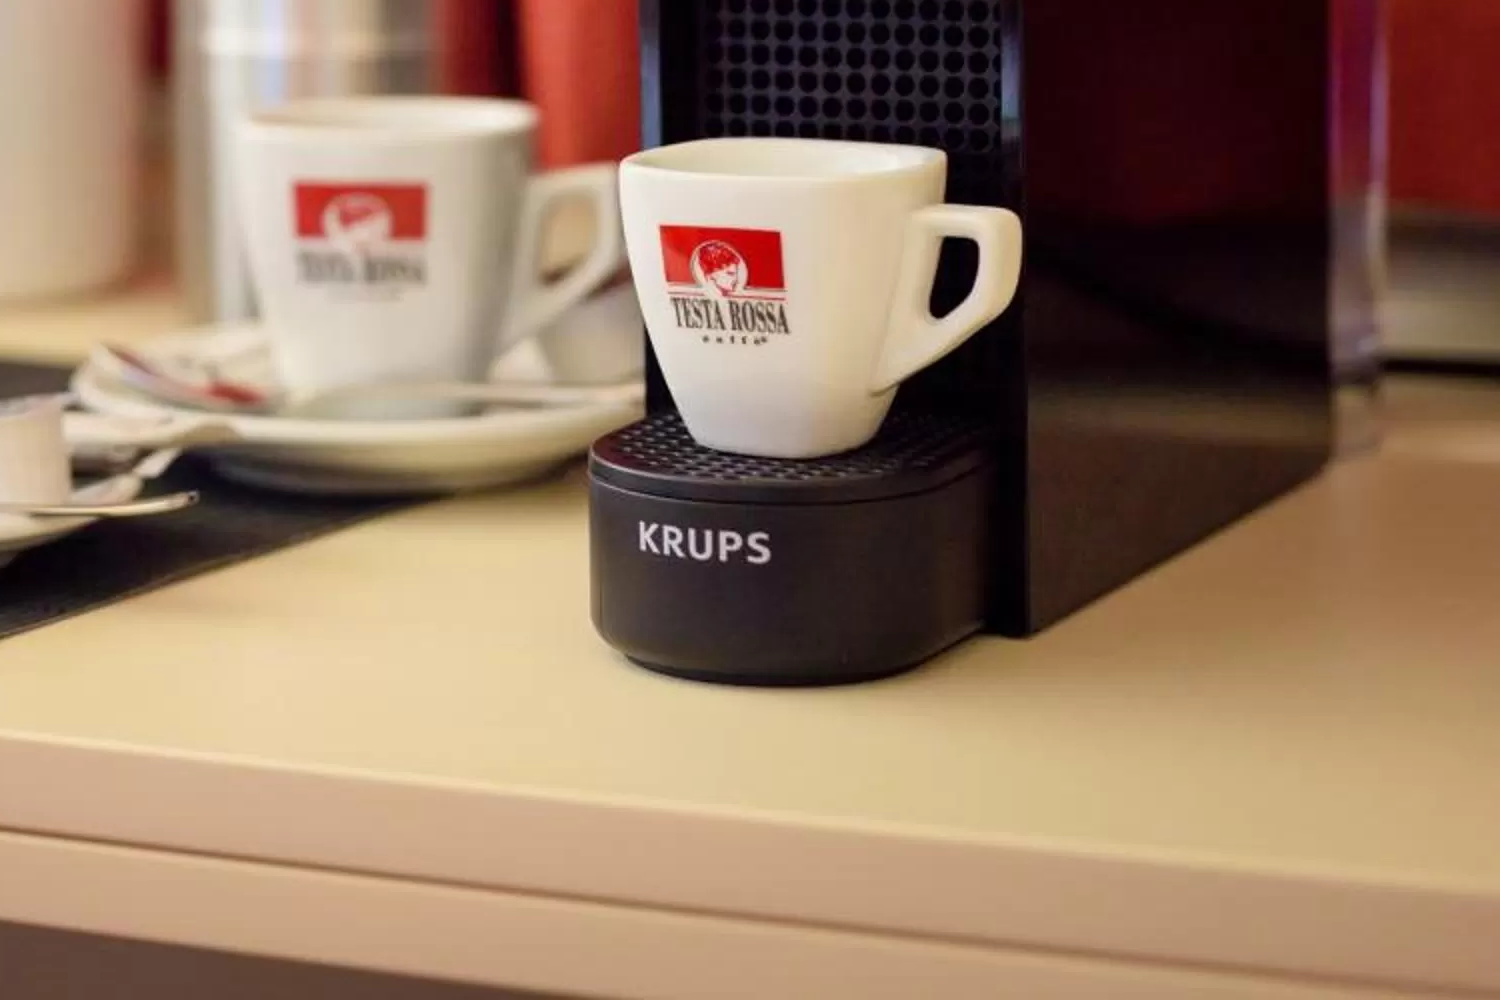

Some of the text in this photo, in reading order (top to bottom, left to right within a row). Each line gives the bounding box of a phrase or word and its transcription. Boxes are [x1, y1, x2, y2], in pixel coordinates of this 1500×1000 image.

[670, 296, 790, 334] TESTA ROSSA
[638, 519, 772, 565] KRUPS
